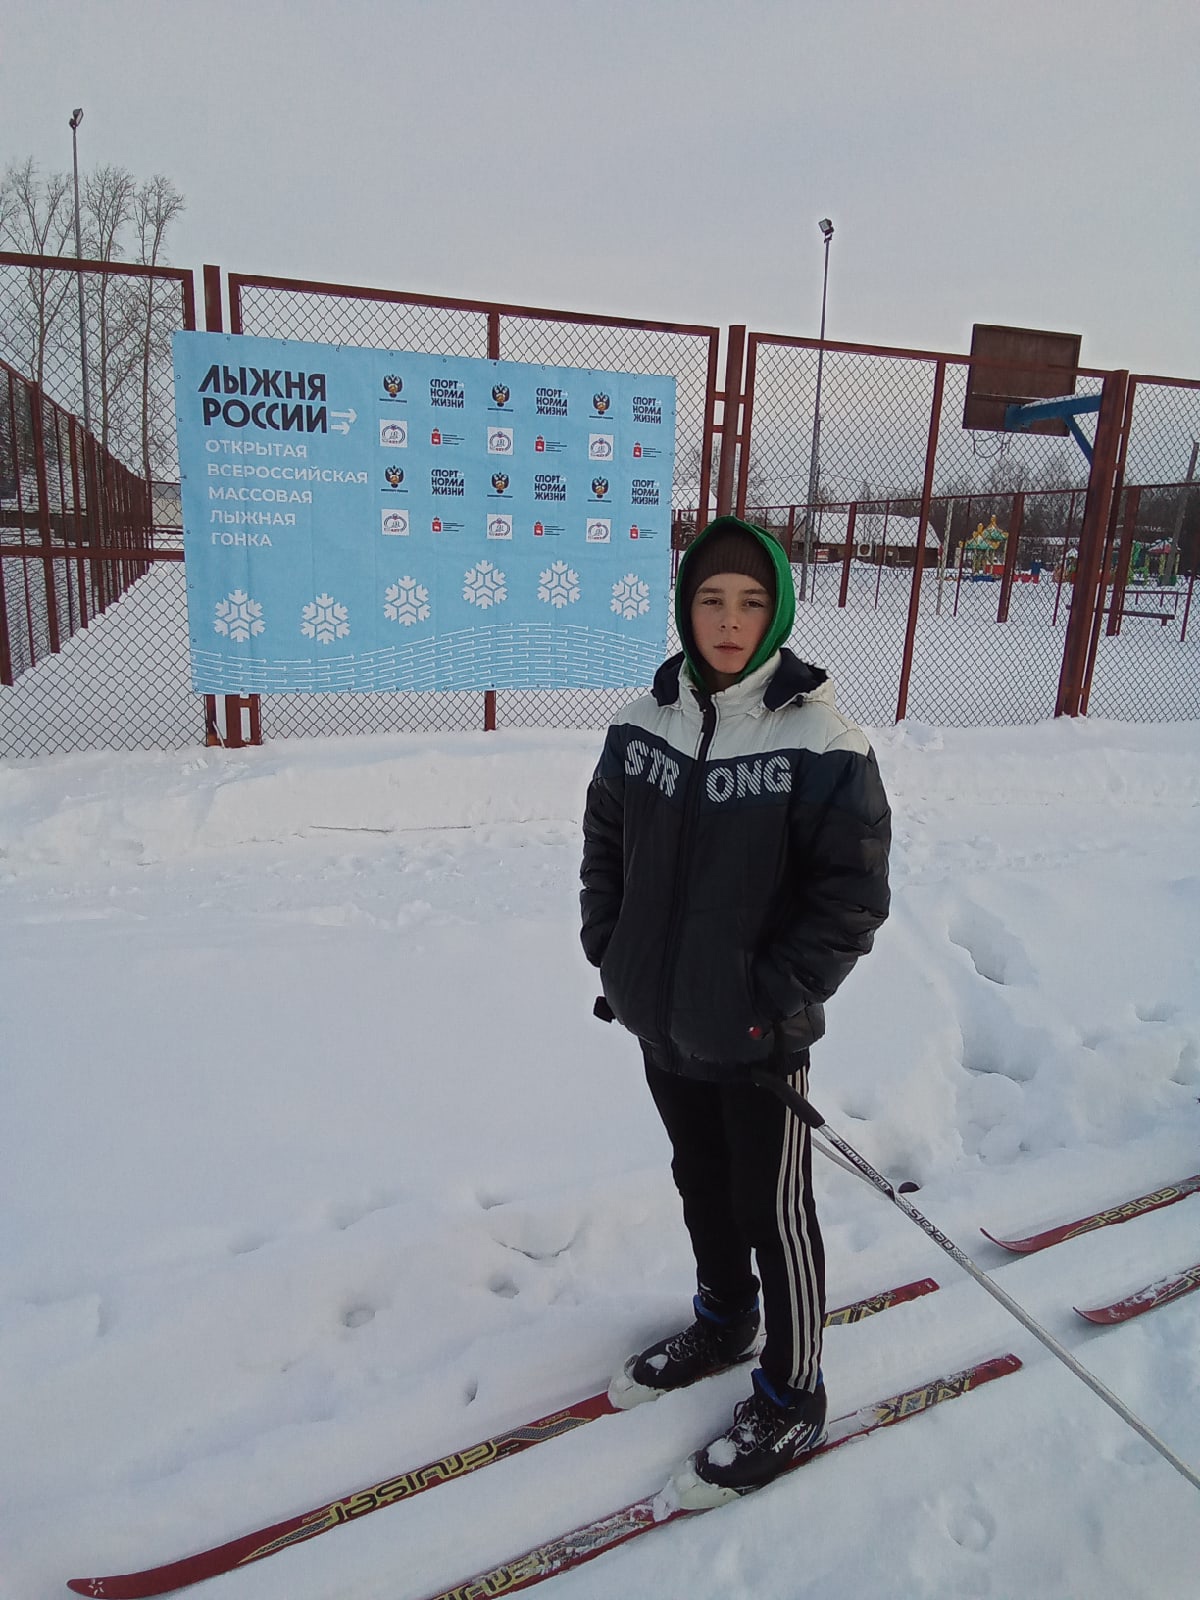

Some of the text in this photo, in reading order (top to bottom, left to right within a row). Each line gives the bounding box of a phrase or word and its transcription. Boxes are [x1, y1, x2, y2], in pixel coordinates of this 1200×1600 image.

[198, 364, 327, 402] ЛЫЖНЯ
[430, 378, 459, 389] СПОРТ
[430, 388, 464, 399] НОРМА
[536, 388, 562, 398] СПОРТ
[431, 398, 464, 409] ЖИЗНИ
[536, 397, 567, 407] НОРМА
[632, 396, 657, 406] СПОРТ
[536, 406, 568, 416] ЖИЗНИ
[632, 405, 662, 415] НОРМА
[202, 397, 328, 434] РОССИИ
[633, 414, 662, 424] ЖИЗНИ
[205, 439, 307, 458] ОТКРЫТАЯ
[207, 463, 368, 484] ВСЕРОССИЙСКАЯ
[431, 468, 459, 478] СПОРТ
[431, 476, 464, 487] НОРМА
[534, 474, 561, 484] СПОРТ
[631, 479, 655, 488] СПОРТ
[431, 486, 464, 496] ЖИЗНИ
[534, 482, 566, 493] НОРМА
[631, 487, 659, 497] НОРМА
[208, 486, 313, 504] МАССОВАЯ
[534, 491, 566, 501] ЖИЗНИ
[631, 496, 659, 505] ЖИЗНИ
[209, 510, 296, 526] ЛЫЖНАЯ
[211, 532, 272, 547] ГОНКА
[772, 1420, 806, 1453] TREK
